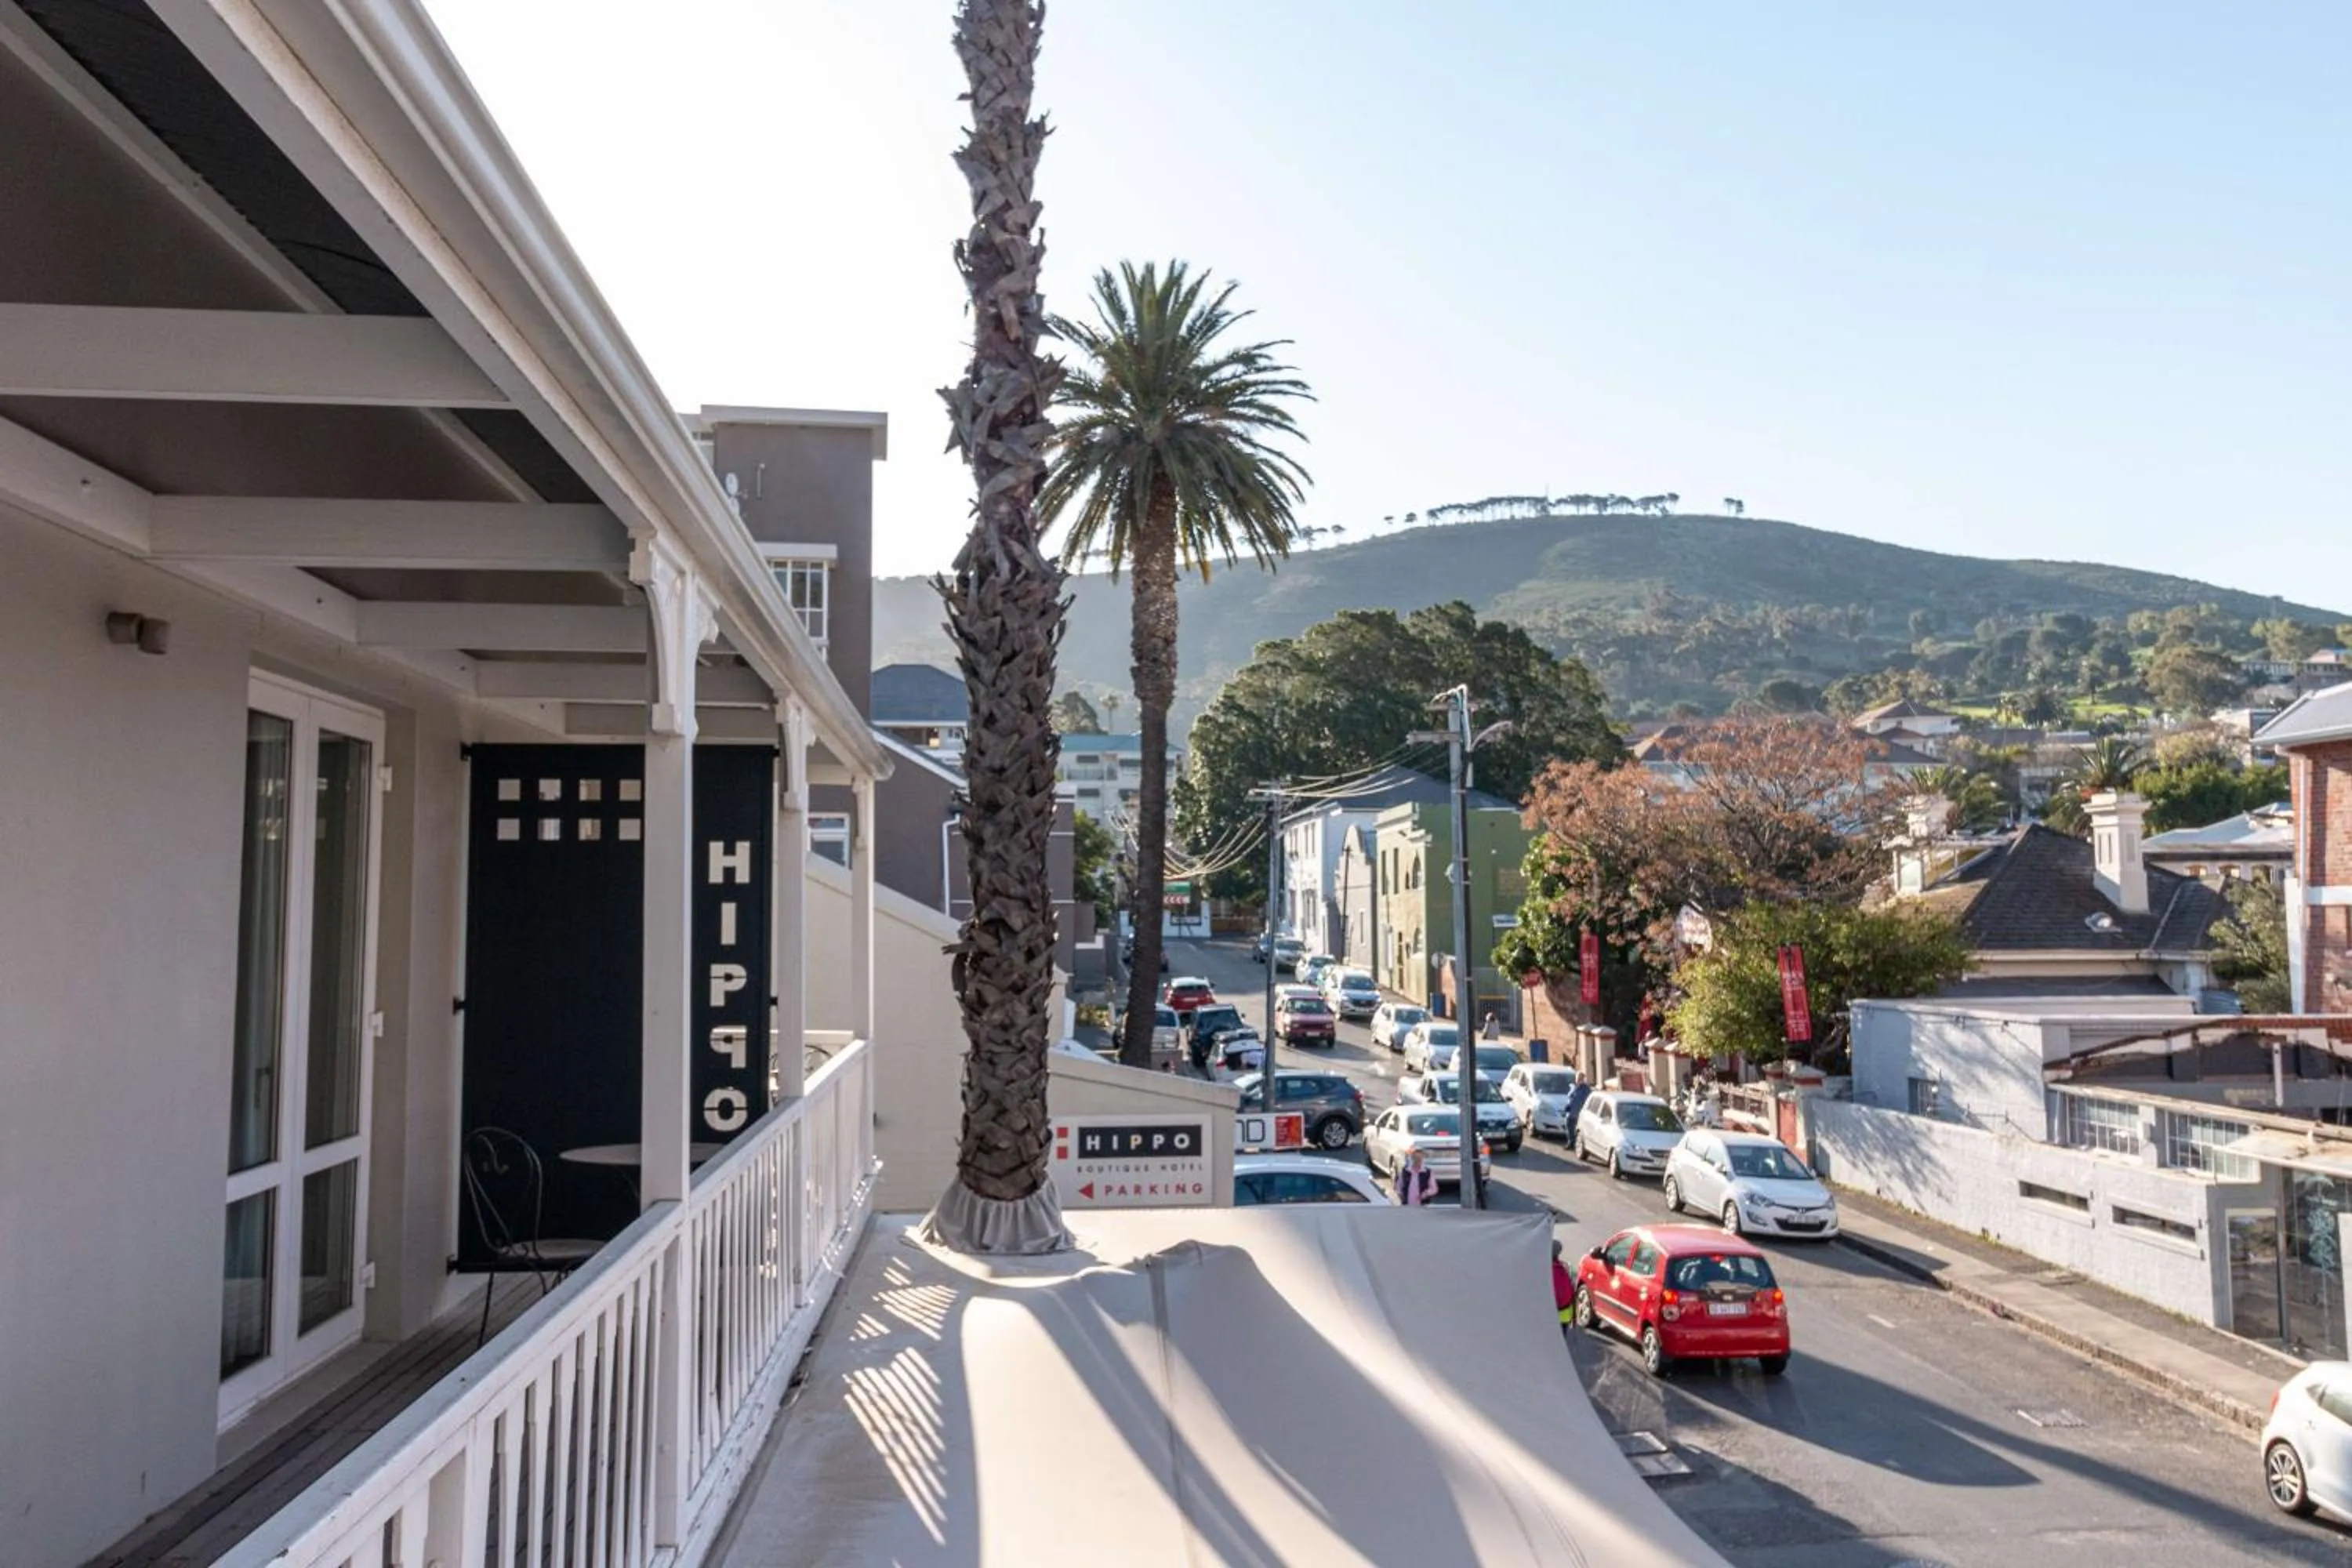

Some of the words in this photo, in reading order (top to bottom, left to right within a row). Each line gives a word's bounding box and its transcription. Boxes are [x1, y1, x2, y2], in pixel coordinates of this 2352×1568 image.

[704, 840, 751, 1131] HIPPO
[1086, 1133, 1190, 1151] HIPPO
[1077, 1164, 1149, 1174] BOUTIQUE
[1160, 1163, 1202, 1172] HOTEL
[1105, 1183, 1203, 1196] PARKING
